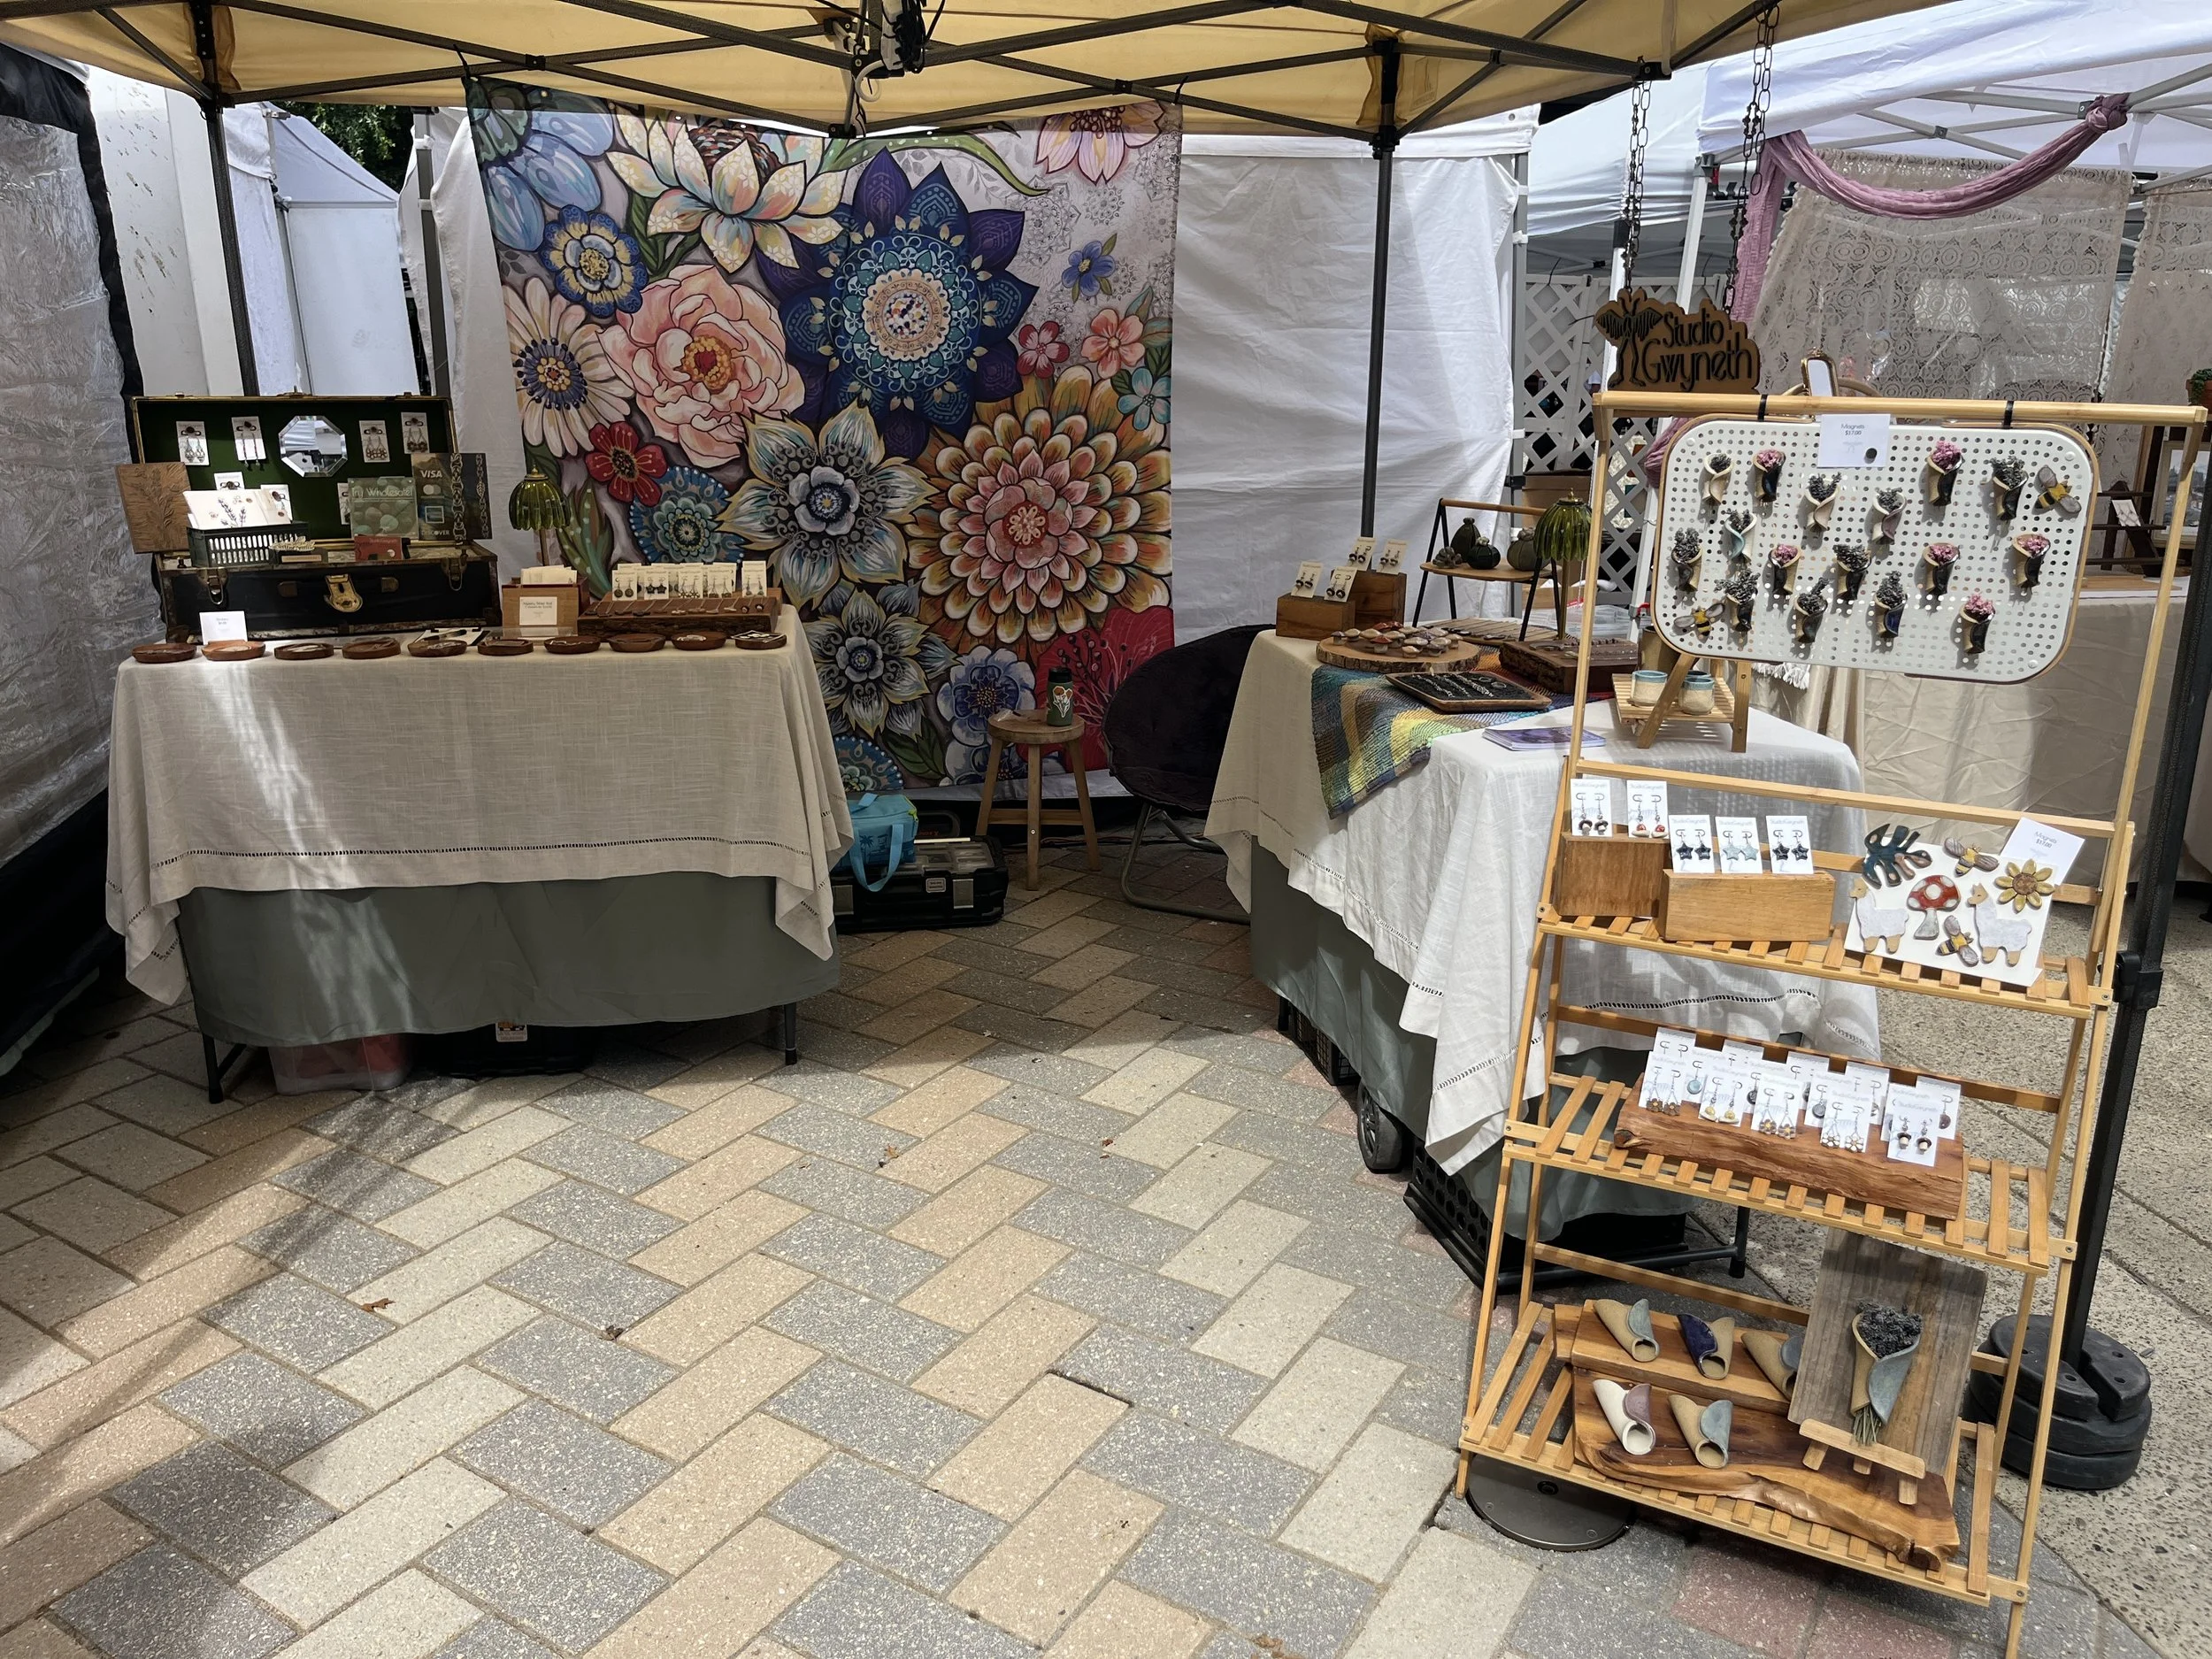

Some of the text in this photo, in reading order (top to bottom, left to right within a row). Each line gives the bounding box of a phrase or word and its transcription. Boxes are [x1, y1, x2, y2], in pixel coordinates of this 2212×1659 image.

[1663, 308, 1724, 348] Studio
[1642, 332, 1753, 392] Gwyneth
[420, 470, 442, 479] VISA
[351, 488, 364, 499] Try
